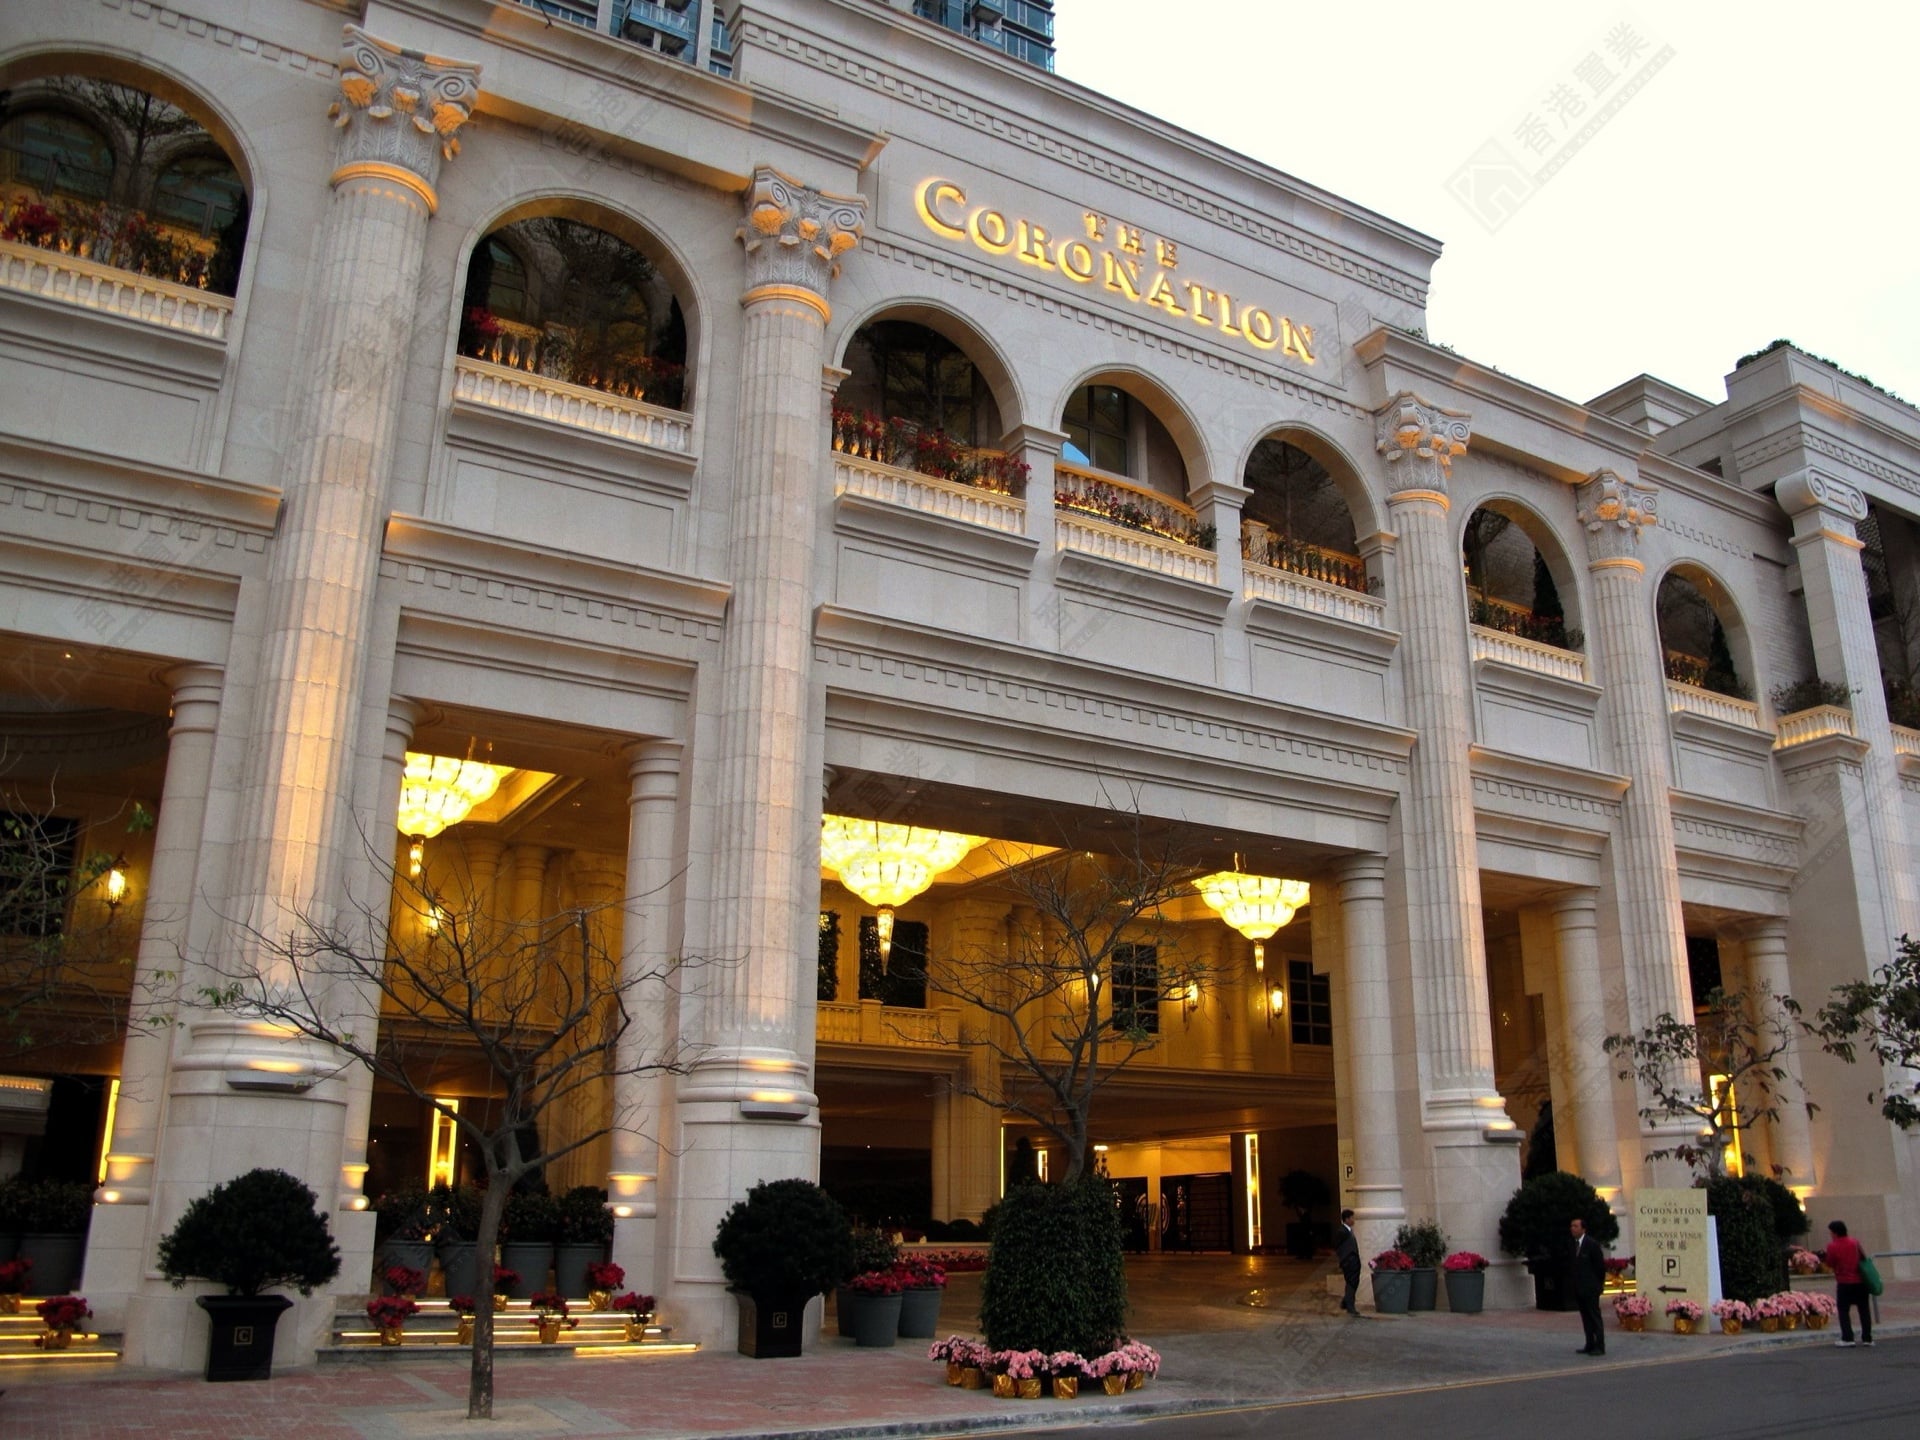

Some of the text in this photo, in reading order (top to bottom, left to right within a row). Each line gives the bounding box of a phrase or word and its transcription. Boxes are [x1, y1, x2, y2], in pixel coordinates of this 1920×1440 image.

[1085, 212, 1179, 269] THE
[916, 180, 1317, 364] CORONATION
[1346, 1166, 1353, 1178] P
[1640, 1206, 1701, 1215] CORONATION
[1666, 1259, 1676, 1274] P
